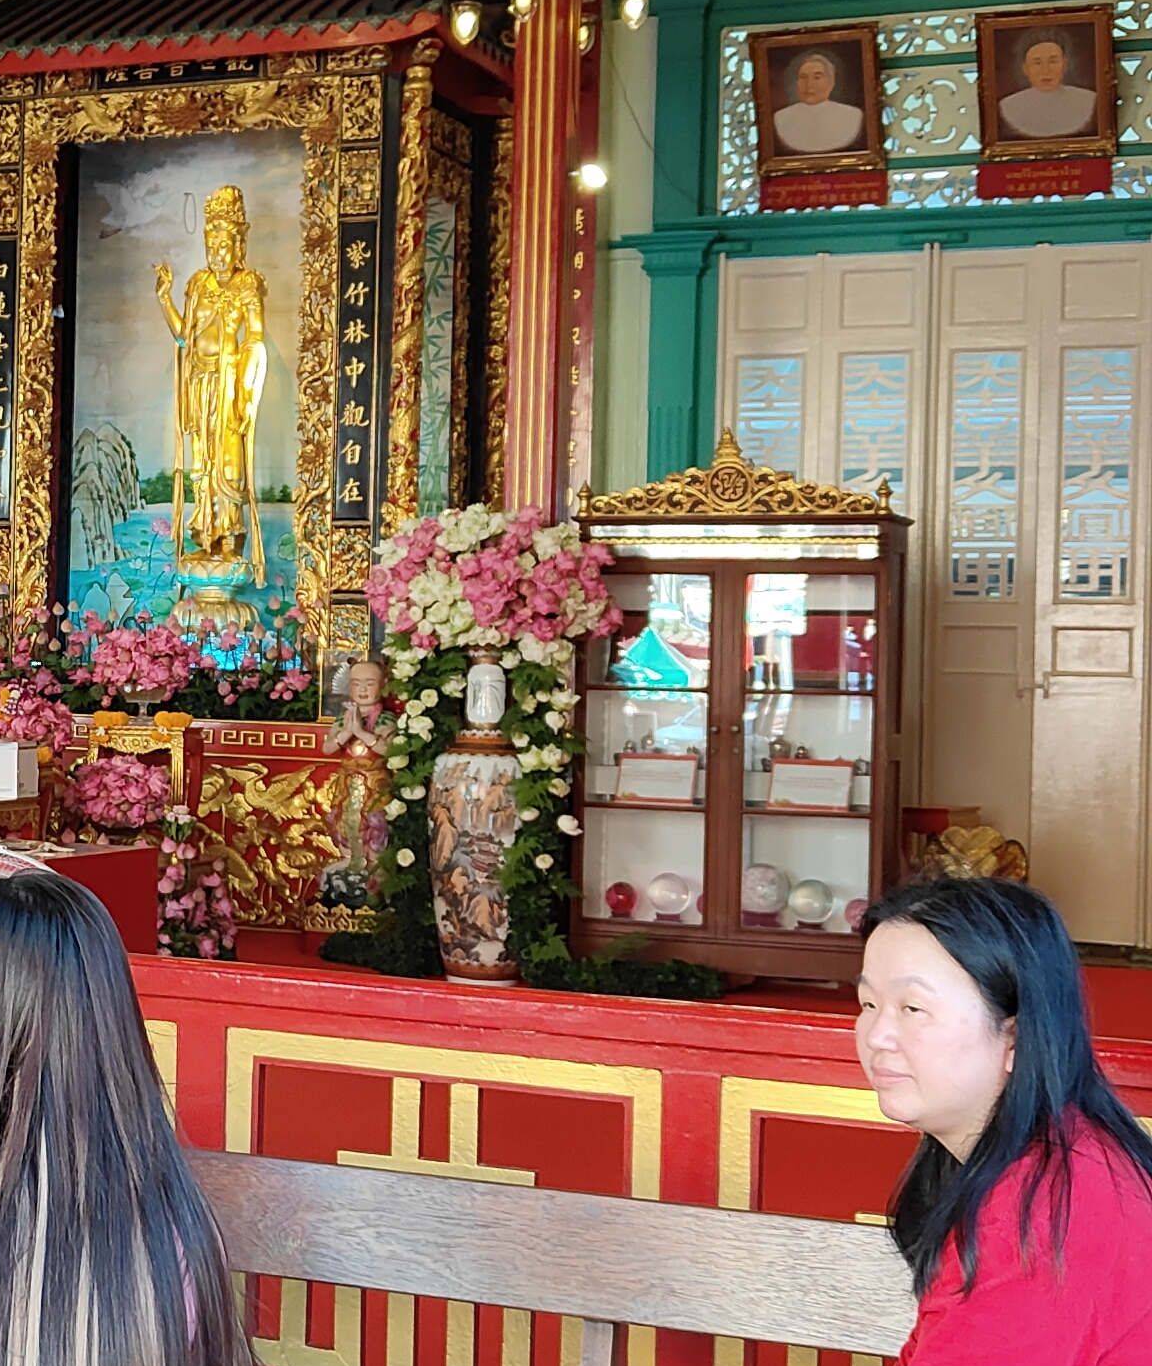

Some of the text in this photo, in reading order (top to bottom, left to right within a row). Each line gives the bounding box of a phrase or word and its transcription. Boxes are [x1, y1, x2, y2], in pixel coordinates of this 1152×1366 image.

[338, 238, 372, 504] 紫竹林中觀自在
